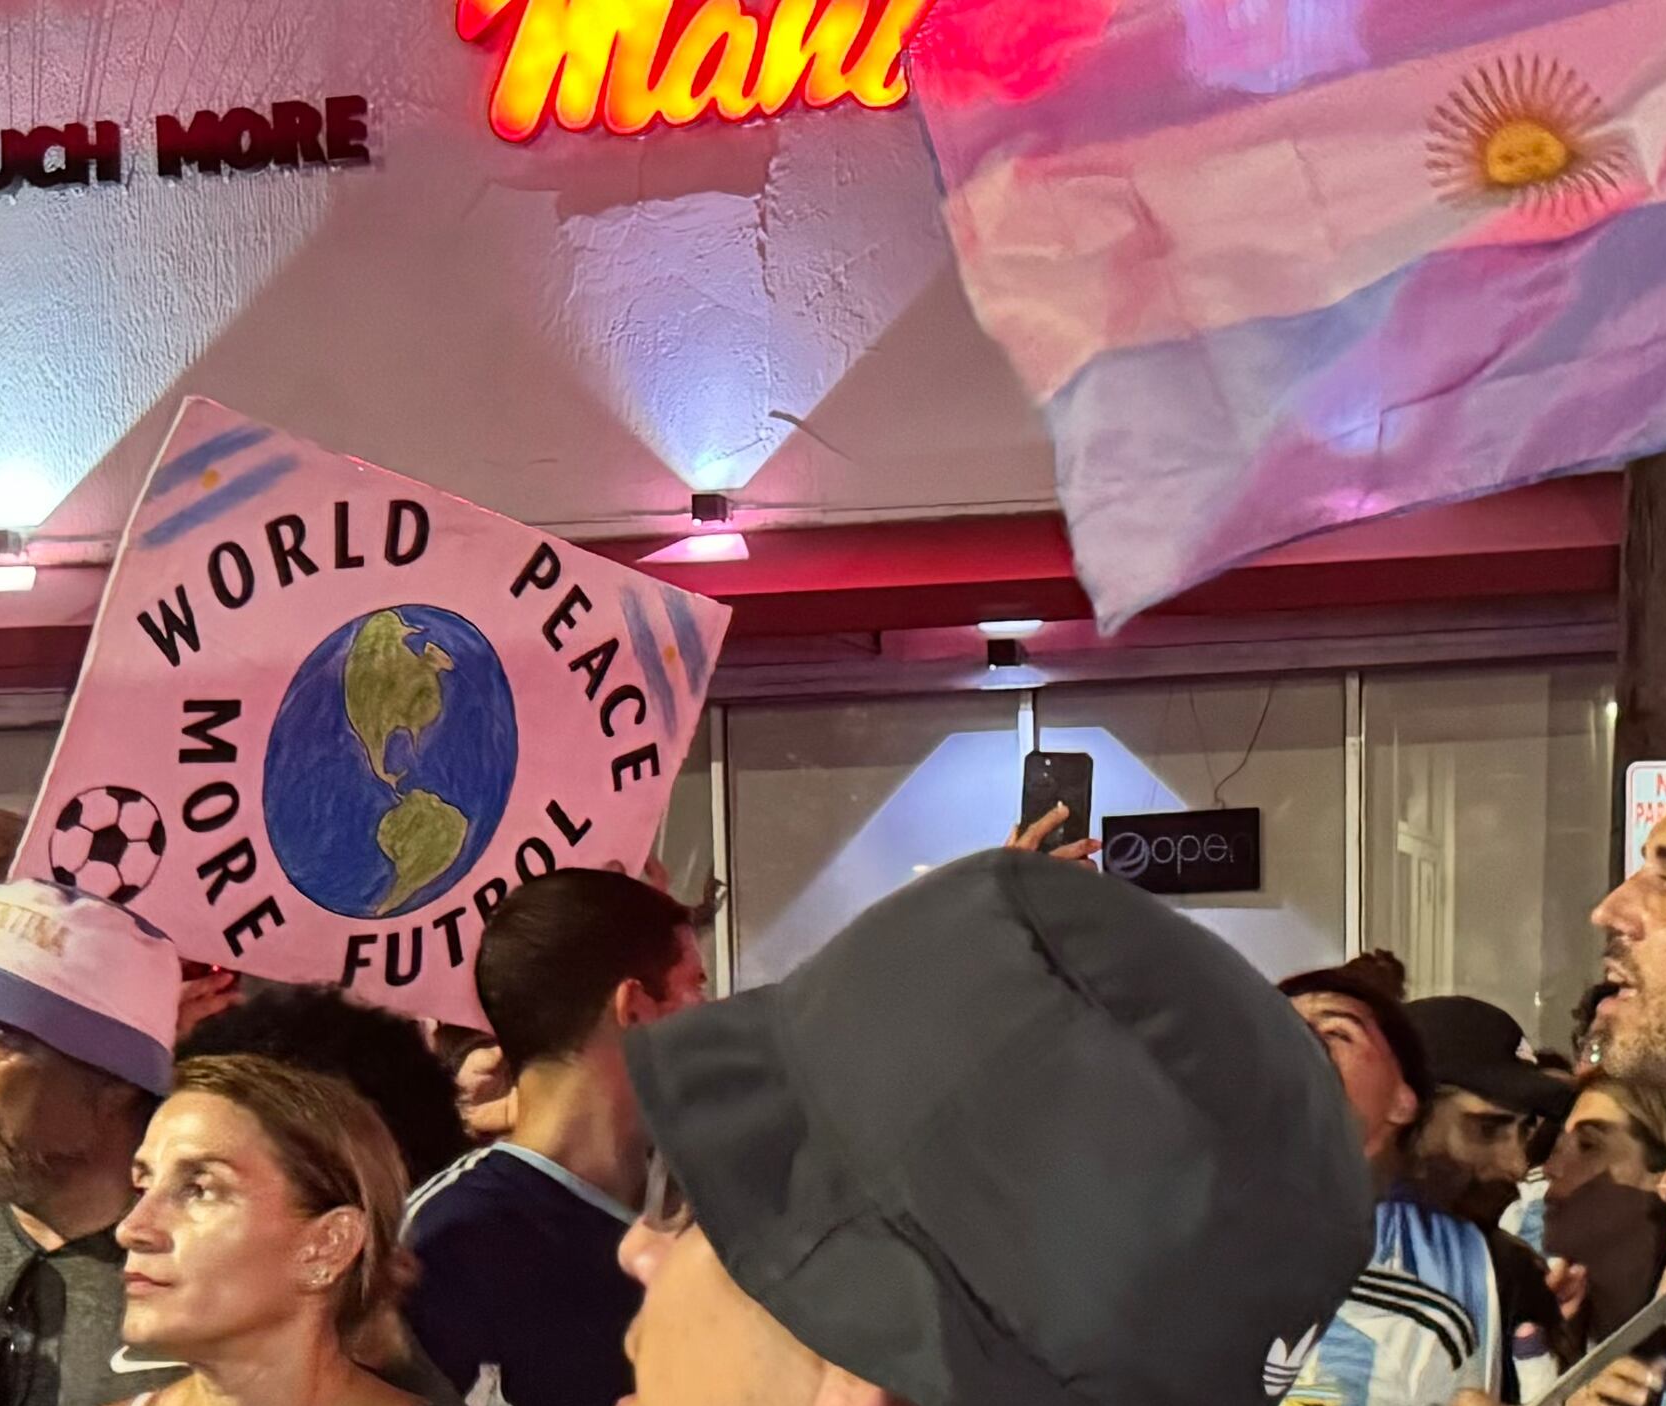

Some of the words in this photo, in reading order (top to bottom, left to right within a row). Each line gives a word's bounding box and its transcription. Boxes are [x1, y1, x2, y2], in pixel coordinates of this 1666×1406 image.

[155, 94, 370, 178] MORE
[136, 498, 431, 668] WORLD
[508, 541, 661, 793] PEACE
[178, 698, 286, 958] MORE
